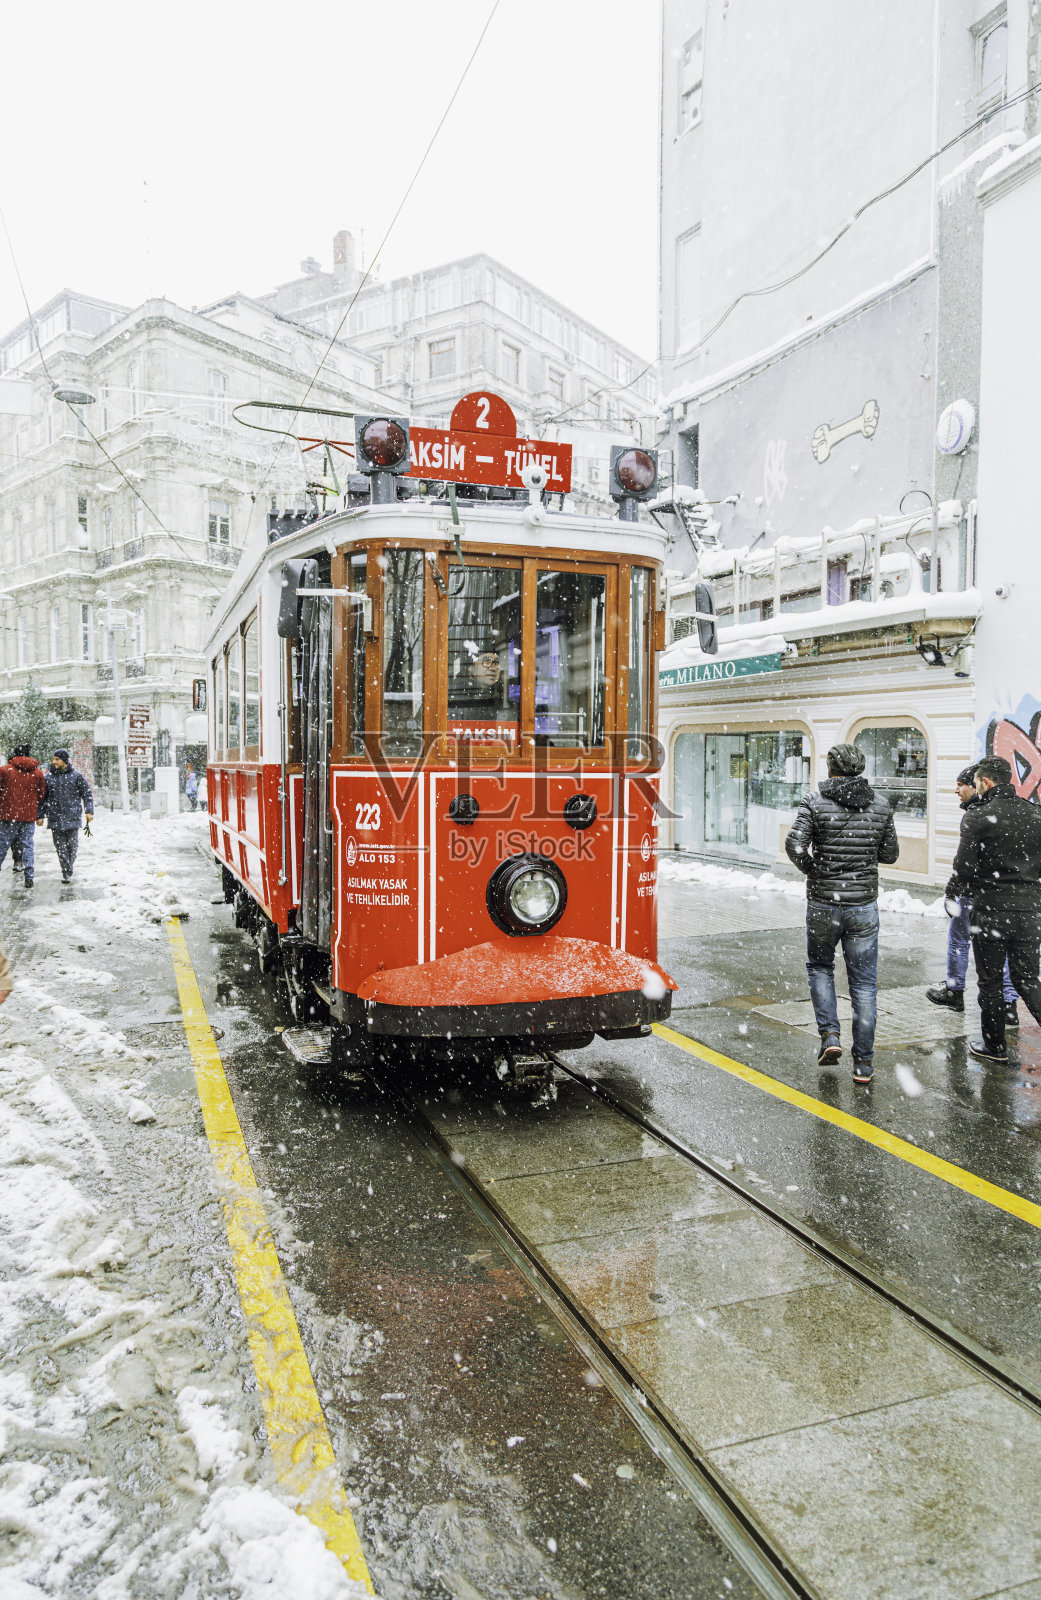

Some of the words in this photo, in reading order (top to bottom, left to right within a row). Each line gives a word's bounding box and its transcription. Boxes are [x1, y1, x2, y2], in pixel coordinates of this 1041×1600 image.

[476, 397, 490, 429] 2
[410, 436, 466, 471] AKSİM
[659, 674, 675, 686] eria
[676, 661, 736, 684] MILANO
[452, 725, 516, 741] TAKSİM
[355, 802, 381, 830] 223
[358, 853, 376, 863] ALO
[377, 854, 396, 864] 153
[347, 876, 378, 890] ASILMAK
[378, 878, 408, 890] YASAK
[346, 892, 354, 904] VE
[355, 892, 410, 906] TEHLİKELİDİR
